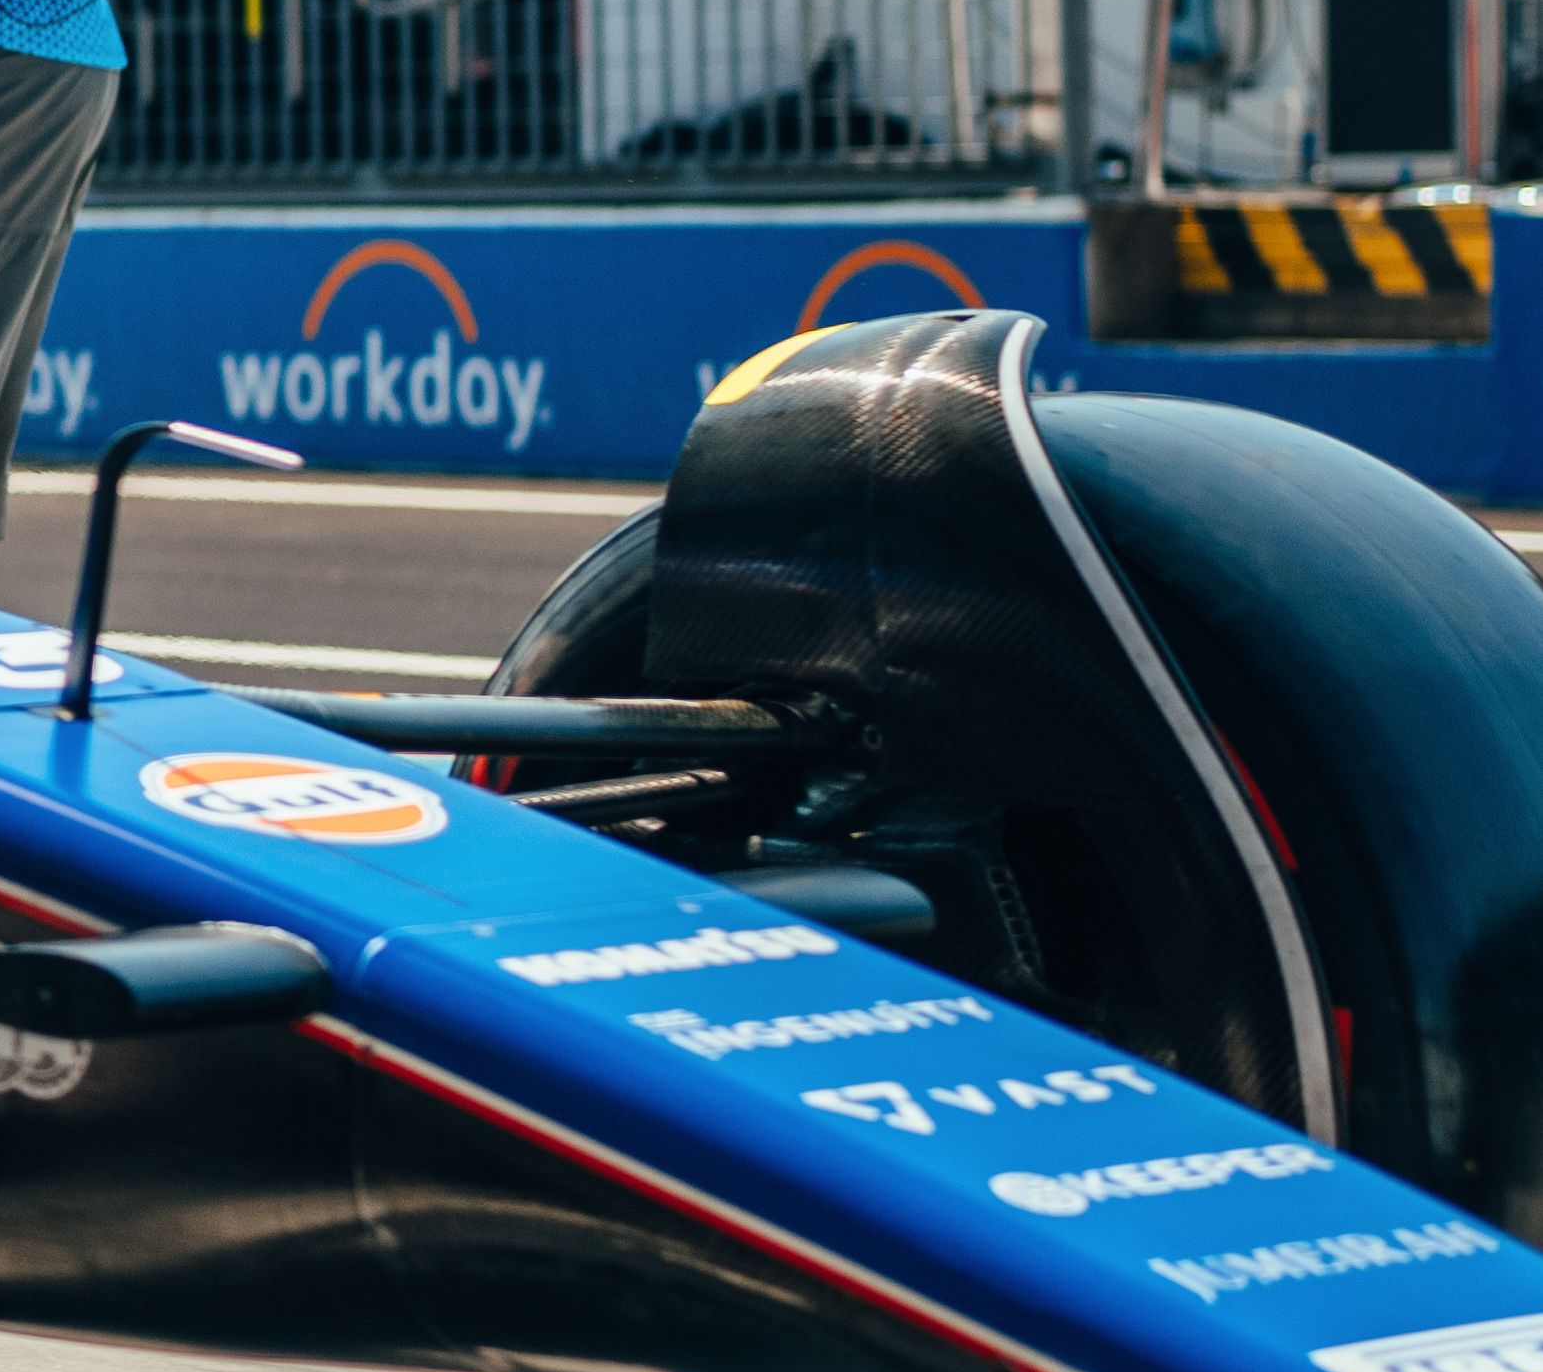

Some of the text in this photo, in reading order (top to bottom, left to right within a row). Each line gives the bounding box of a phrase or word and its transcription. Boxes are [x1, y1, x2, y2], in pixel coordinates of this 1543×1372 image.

[183, 777, 402, 816] Gulf
[926, 1064, 1158, 1116] VAST
[1057, 1144, 1336, 1203] KEEPER
